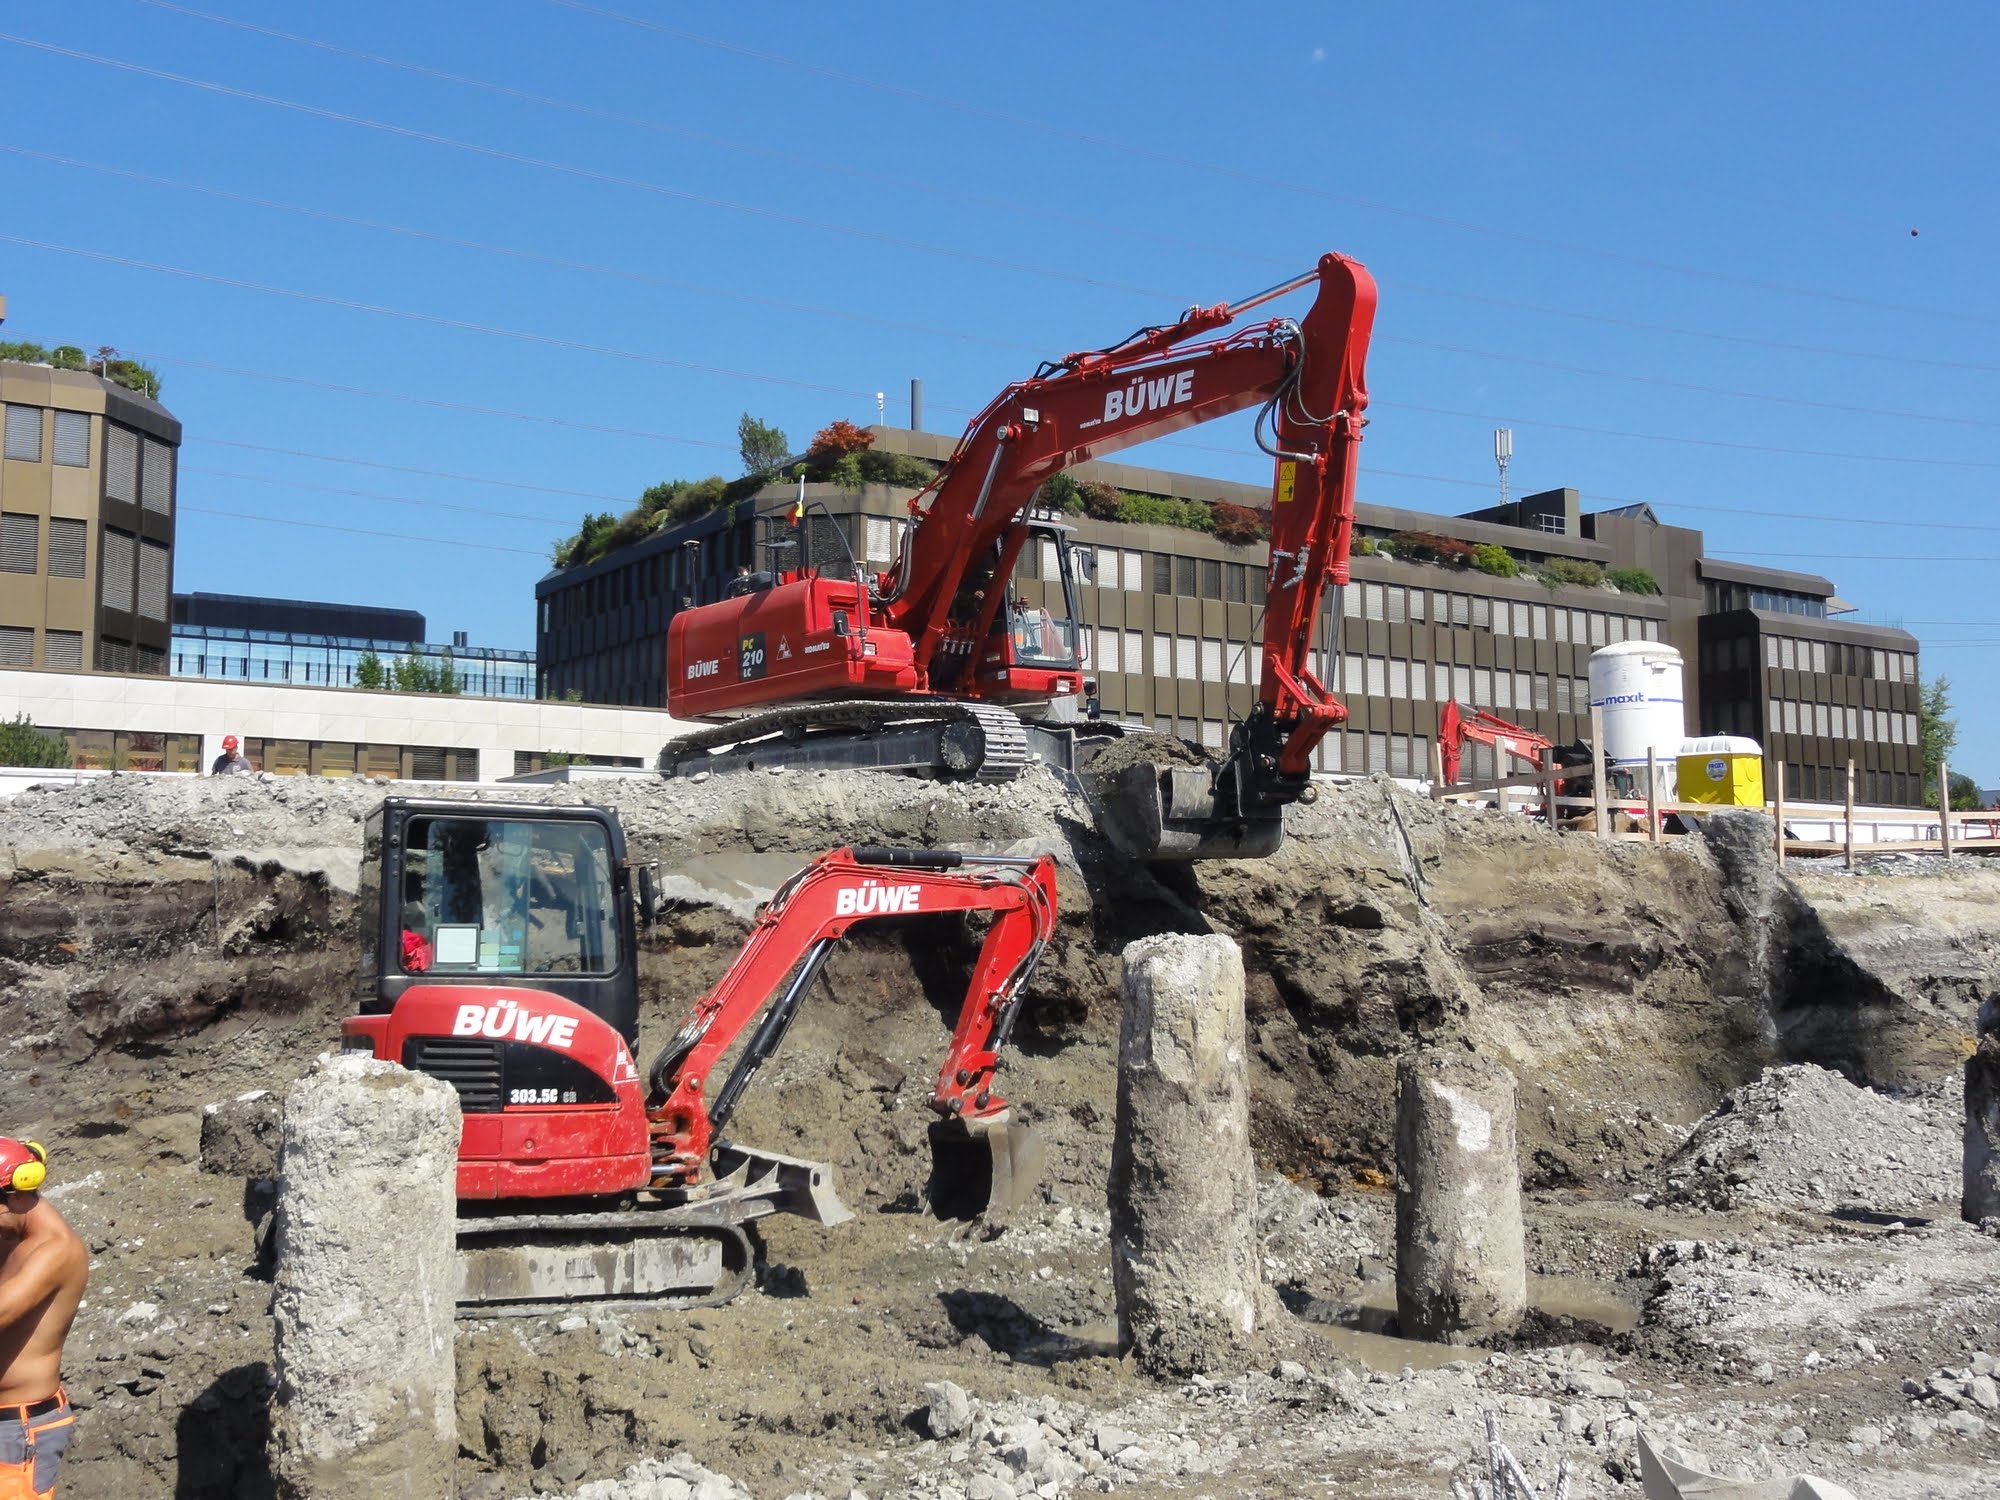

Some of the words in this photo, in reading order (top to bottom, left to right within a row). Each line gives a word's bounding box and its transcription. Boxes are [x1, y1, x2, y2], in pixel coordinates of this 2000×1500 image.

[1104, 369, 1194, 422] BÜWE
[742, 638, 754, 651] PC
[742, 649, 764, 667] 210
[687, 659, 719, 680] BÜWE
[743, 668, 752, 678] LC
[1605, 692, 1645, 705] maxit
[835, 880, 921, 915] BÜWE
[452, 999, 579, 1048] BÜWE
